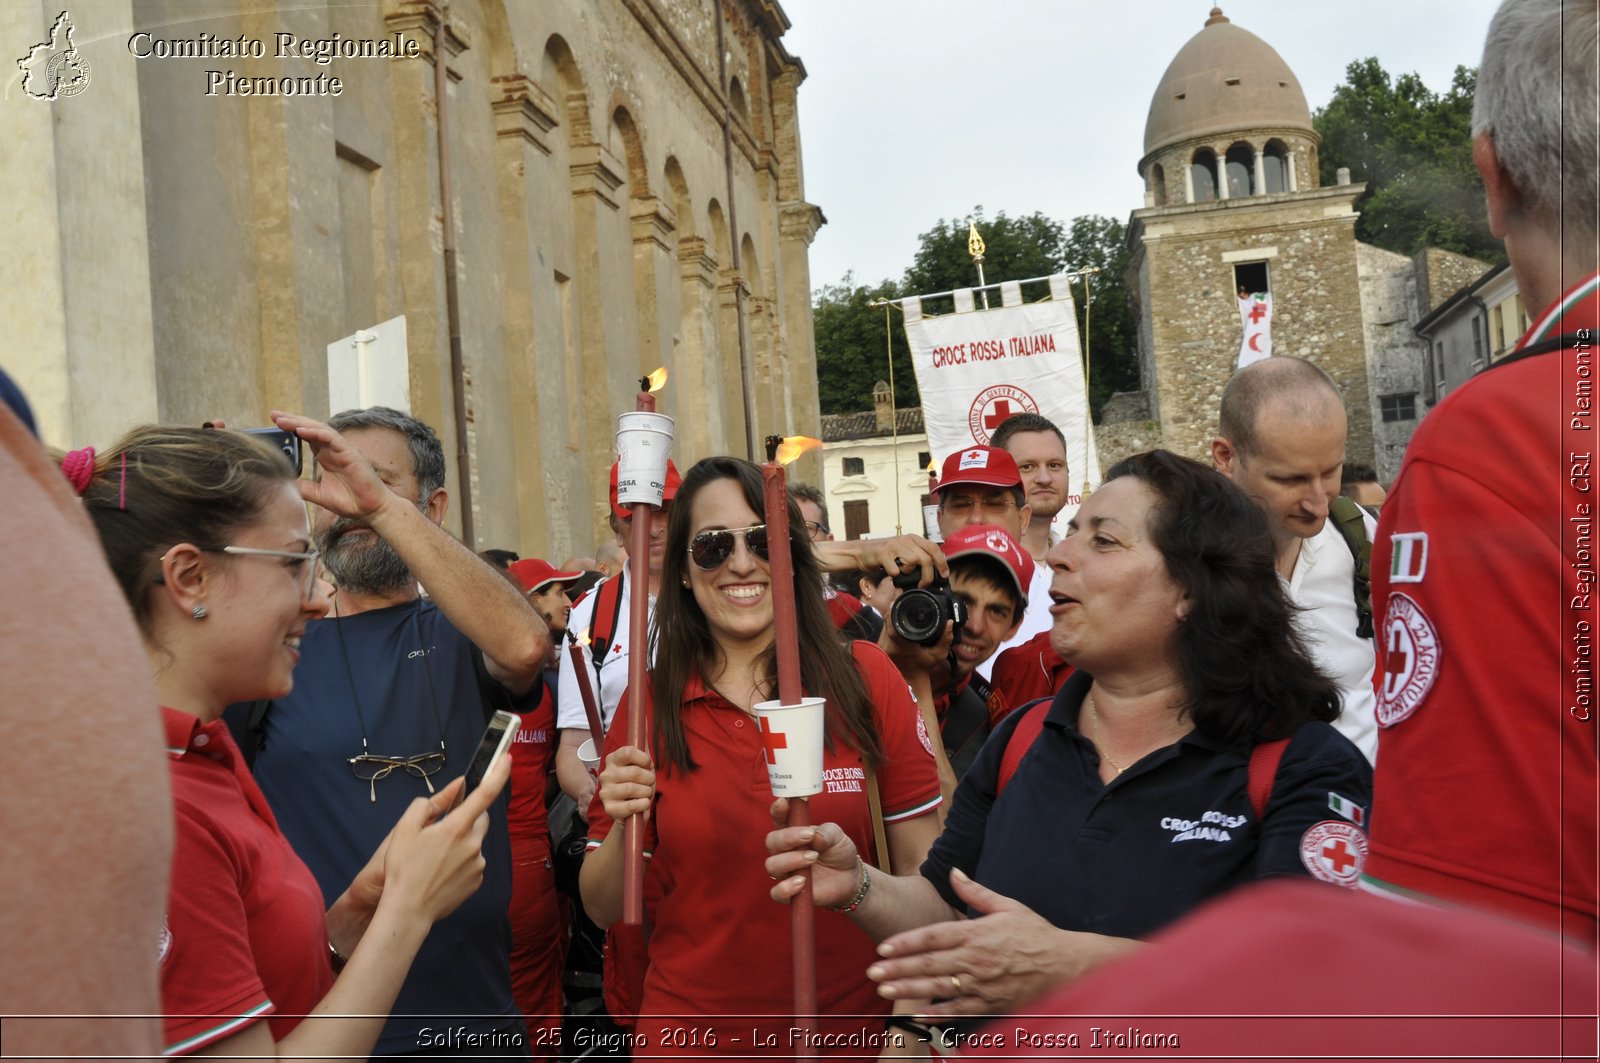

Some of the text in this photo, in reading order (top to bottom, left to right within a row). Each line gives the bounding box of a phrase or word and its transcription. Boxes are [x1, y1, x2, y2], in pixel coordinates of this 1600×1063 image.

[932, 333, 1057, 369] CROCE ROSSA ITALIANA
[978, 396, 986, 406] DI
[986, 387, 1016, 399] GINEVRA
[1411, 623, 1430, 643] 22
[1405, 644, 1435, 702] AGOSTO
[512, 729, 546, 743] TALIANA
[821, 769, 844, 781] ROCE
[826, 780, 862, 793] ITALIANA
